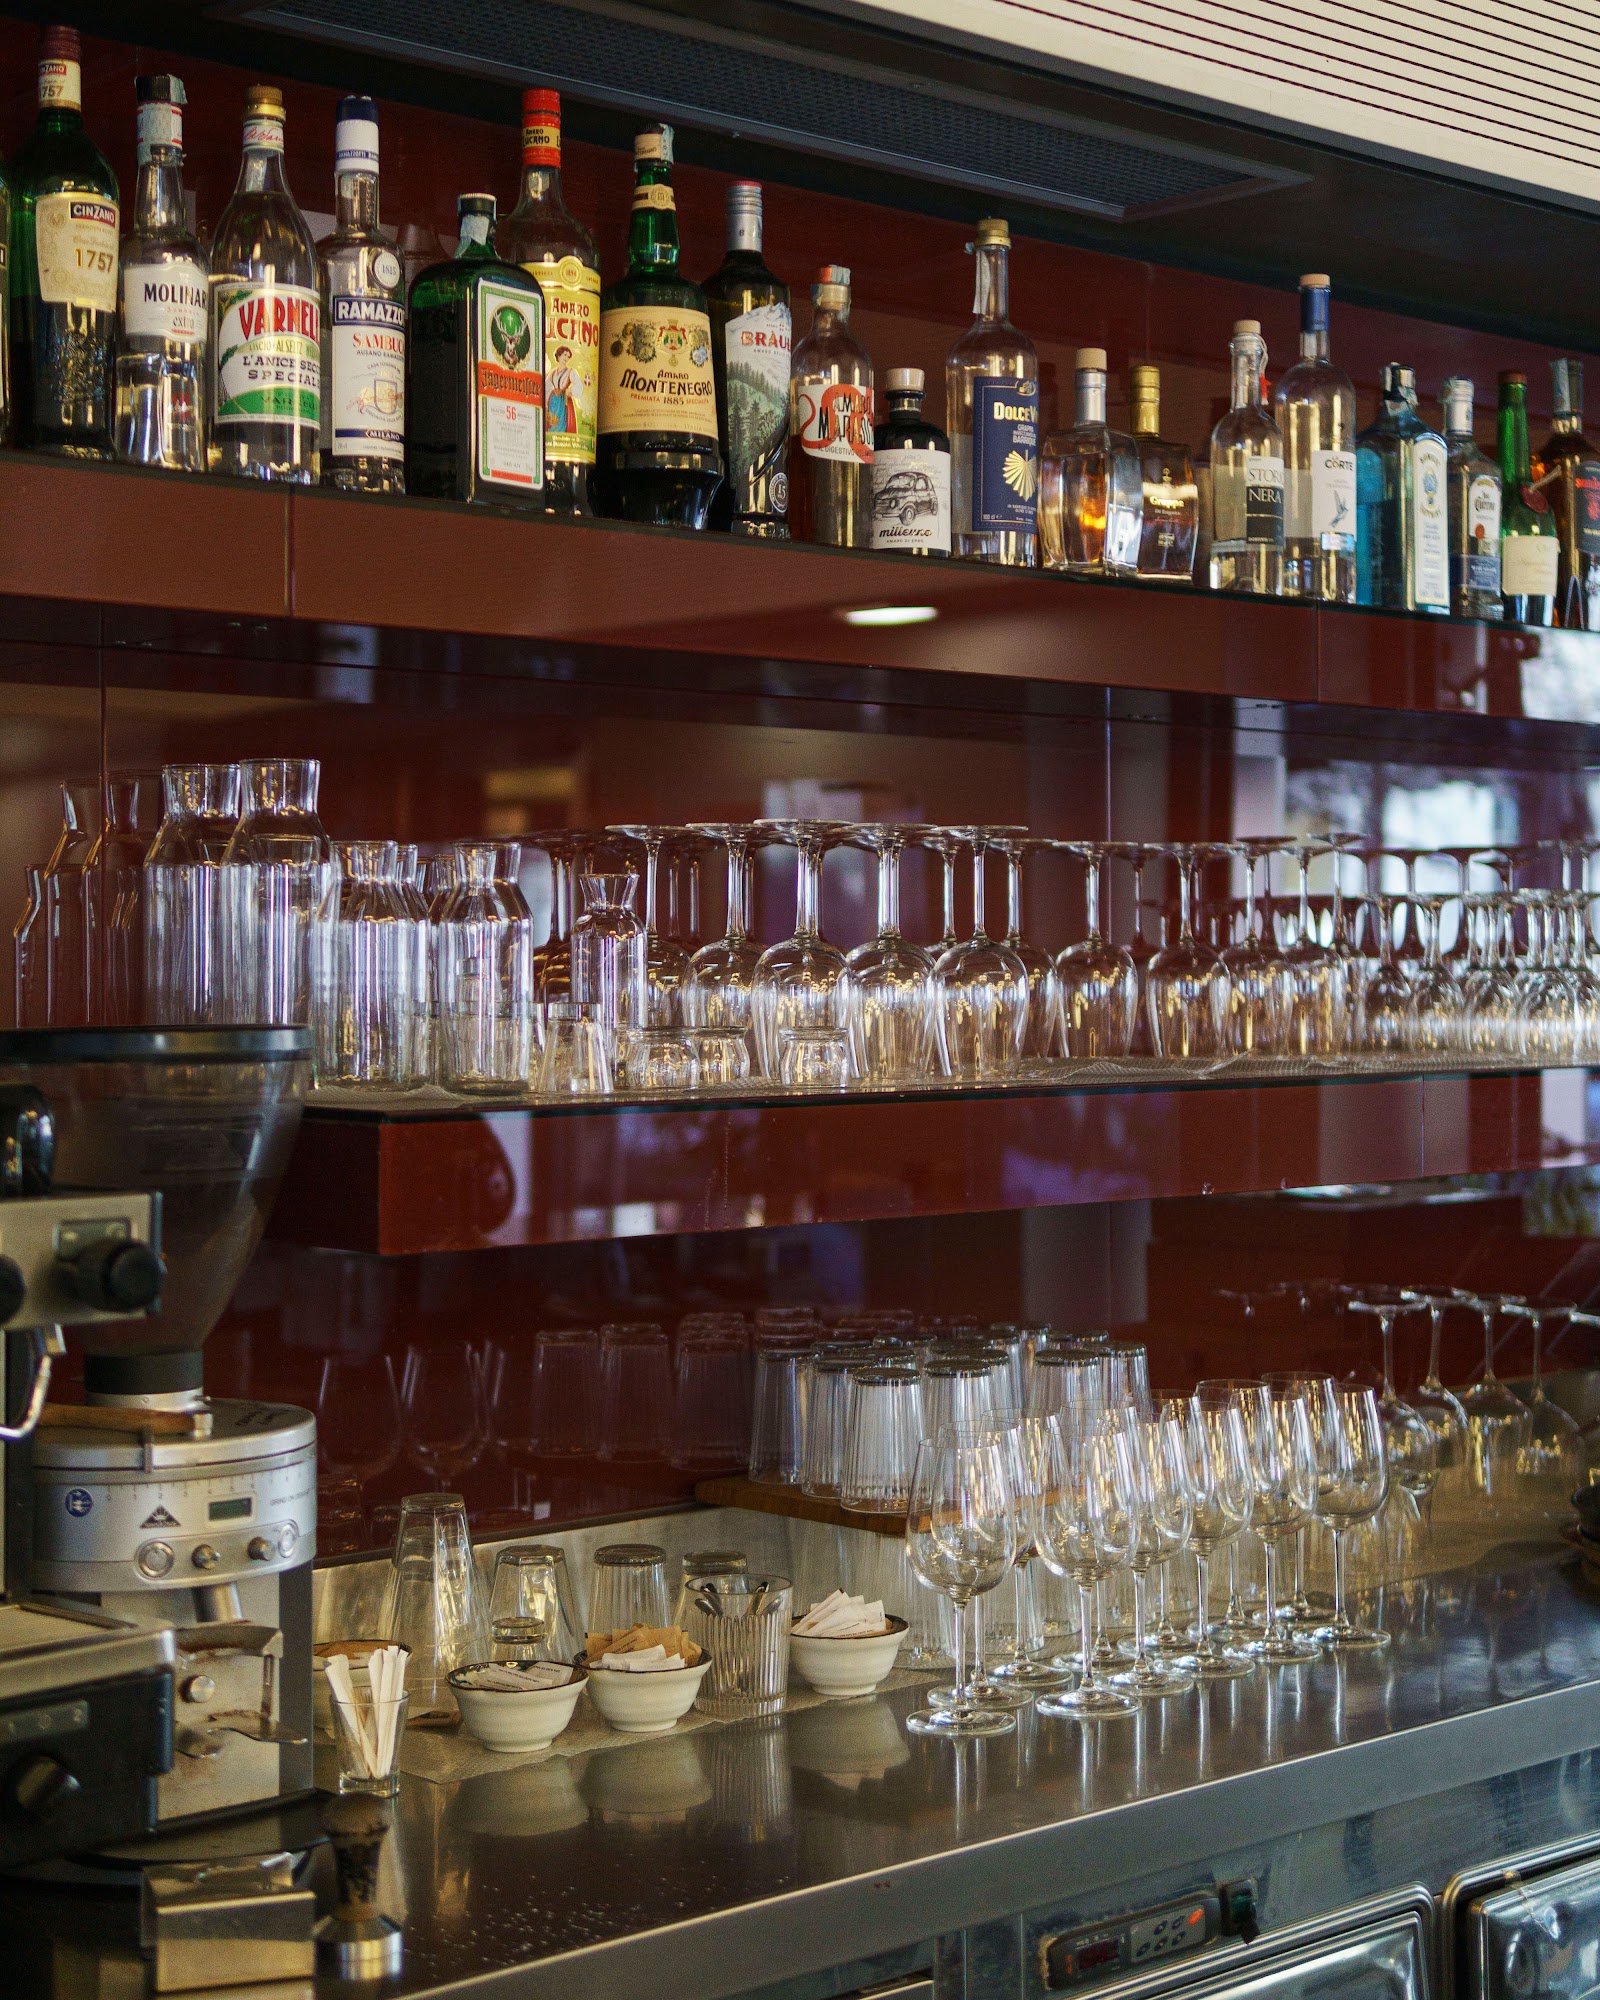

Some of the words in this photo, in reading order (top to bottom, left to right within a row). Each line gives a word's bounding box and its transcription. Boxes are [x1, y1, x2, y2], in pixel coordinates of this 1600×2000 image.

[73, 204, 115, 224] CINZANO
[75, 247, 114, 273] 1757
[338, 301, 405, 325] RAMAZZO
[553, 297, 590, 317] AMARO
[546, 317, 599, 347] UCANO
[243, 355, 295, 368] L'ANICE
[620, 368, 713, 396] MONTENEGRO
[657, 369, 689, 380] AMARO
[630, 392, 660, 402] PREMIATA
[663, 396, 684, 406] 1885
[506, 405, 517, 421] 56
[370, 430, 400, 440] MILANO
[1325, 459, 1354, 472] CORTE
[1248, 488, 1282, 504] NERA
[879, 526, 933, 538] milleuno
